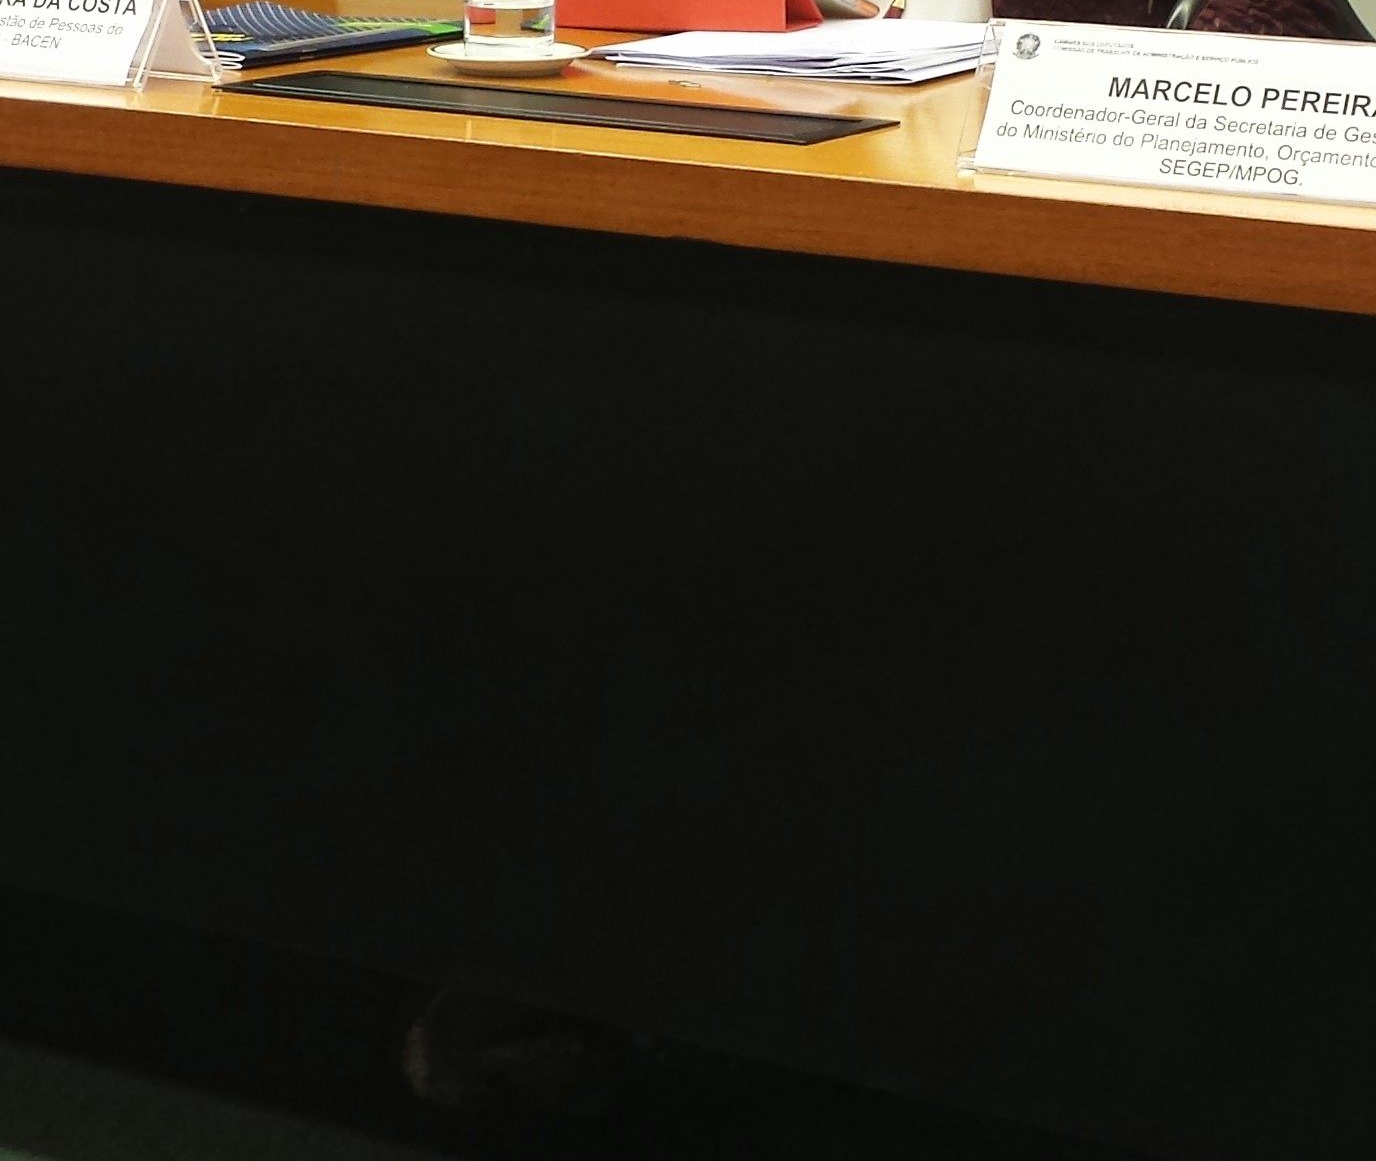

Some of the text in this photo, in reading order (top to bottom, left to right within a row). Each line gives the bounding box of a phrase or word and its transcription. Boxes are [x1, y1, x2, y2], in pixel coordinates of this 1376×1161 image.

[29, 16, 45, 28] de
[48, 17, 103, 33] Pessoas
[106, 22, 123, 35] do
[10, 33, 61, 48] BACEN
[1108, 76, 1251, 106] MARCELO
[1010, 99, 1180, 127] Coordenador-Geral
[1185, 113, 1206, 129] da
[1213, 115, 1306, 137] Secretaria
[1313, 124, 1336, 140] de
[996, 122, 1017, 136] do
[1023, 123, 1106, 144] Ministério
[1112, 131, 1134, 146] do
[1140, 133, 1268, 159] Planejamento,
[1159, 158, 1302, 186] SEGEP/MPOG.
